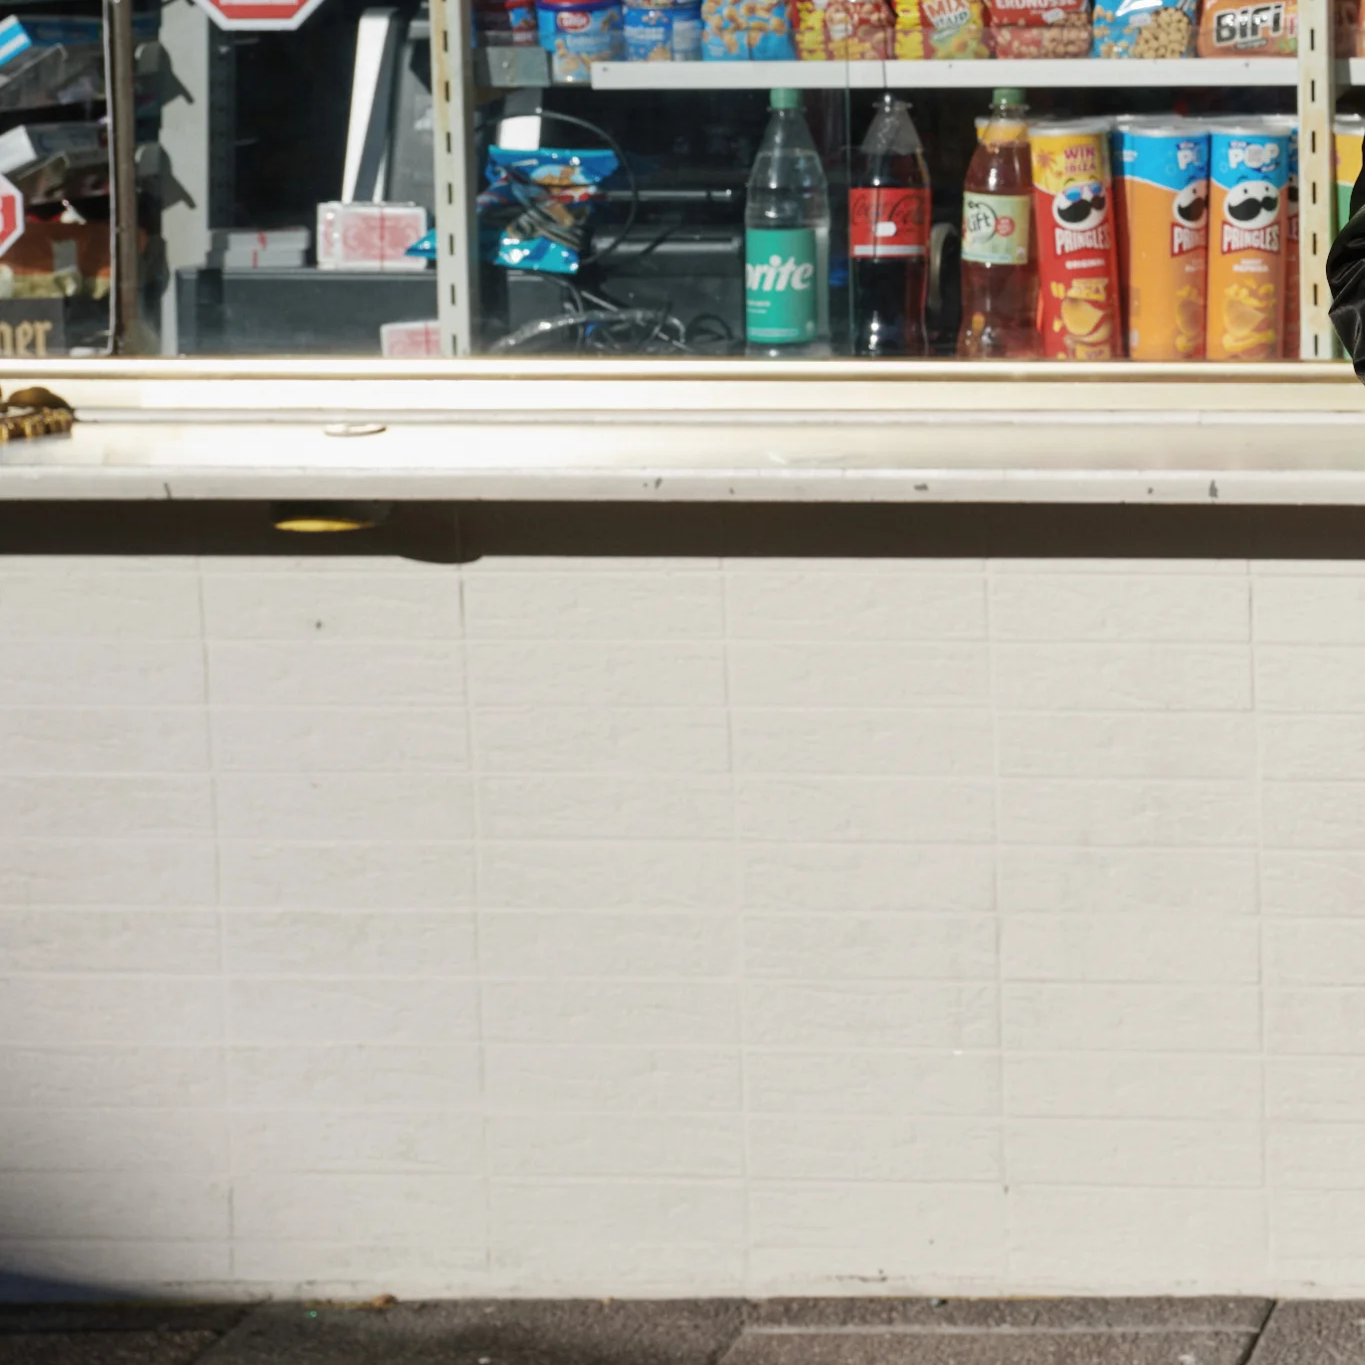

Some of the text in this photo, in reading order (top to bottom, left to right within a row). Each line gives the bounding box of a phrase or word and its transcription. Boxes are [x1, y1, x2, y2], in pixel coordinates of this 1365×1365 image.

[1214, 1, 1286, 45] BiFi
[1064, 146, 1096, 160] WIN
[1228, 142, 1280, 169] POP
[1054, 224, 1110, 256] PRINGLES
[1221, 223, 1280, 253] PRINGLES
